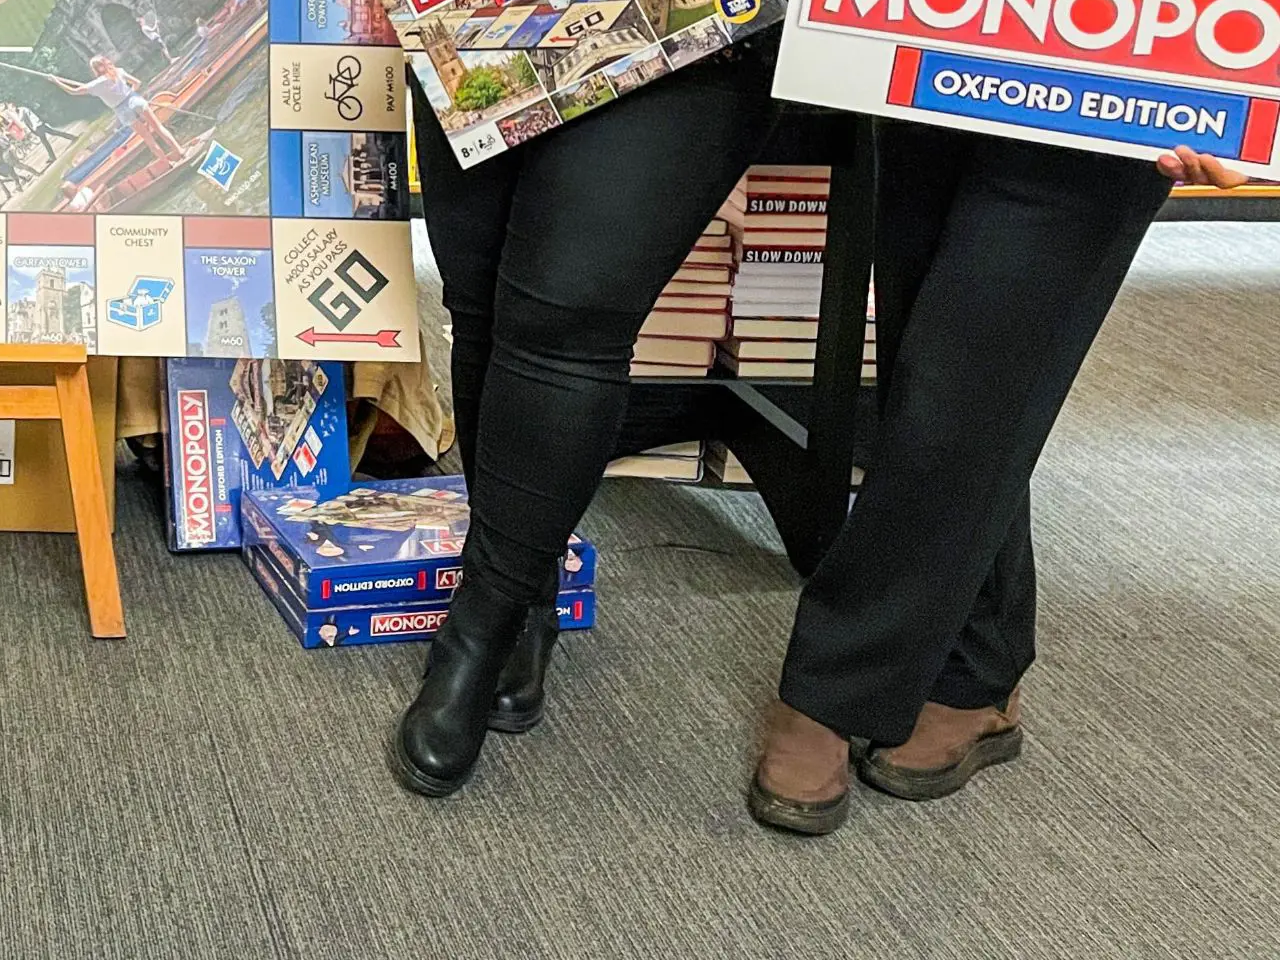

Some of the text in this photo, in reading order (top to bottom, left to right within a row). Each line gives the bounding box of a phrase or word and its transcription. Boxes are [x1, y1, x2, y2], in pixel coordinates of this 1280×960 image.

[317, 0, 327, 29] TOWN
[565, 11, 604, 37] GO
[282, 67, 290, 86] DAY
[293, 61, 302, 113] CYCLE HIRE
[386, 93, 395, 113] PAY
[932, 68, 1227, 140] OXFORD EDITION
[309, 142, 320, 206] ASHMOLEAN
[320, 152, 330, 197] MUSEUM
[750, 200, 827, 213] SLOW DOWN
[109, 227, 169, 237] COMMUNITY
[124, 238, 154, 247] CHEST
[305, 227, 339, 263] SALARY
[284, 228, 320, 265] COLLECT
[746, 250, 823, 263] SLOW DOWN
[13, 257, 88, 268] CARFAX TOWER
[200, 256, 257, 266] THE SAXON
[212, 266, 246, 277] TOWER
[298, 240, 348, 294] AS YOU PASS
[307, 248, 390, 332] GO
[179, 393, 216, 542] MONOPOLY
[215, 428, 227, 502] OXFORD EDITION
[333, 576, 414, 592] OXFORD EDITION
